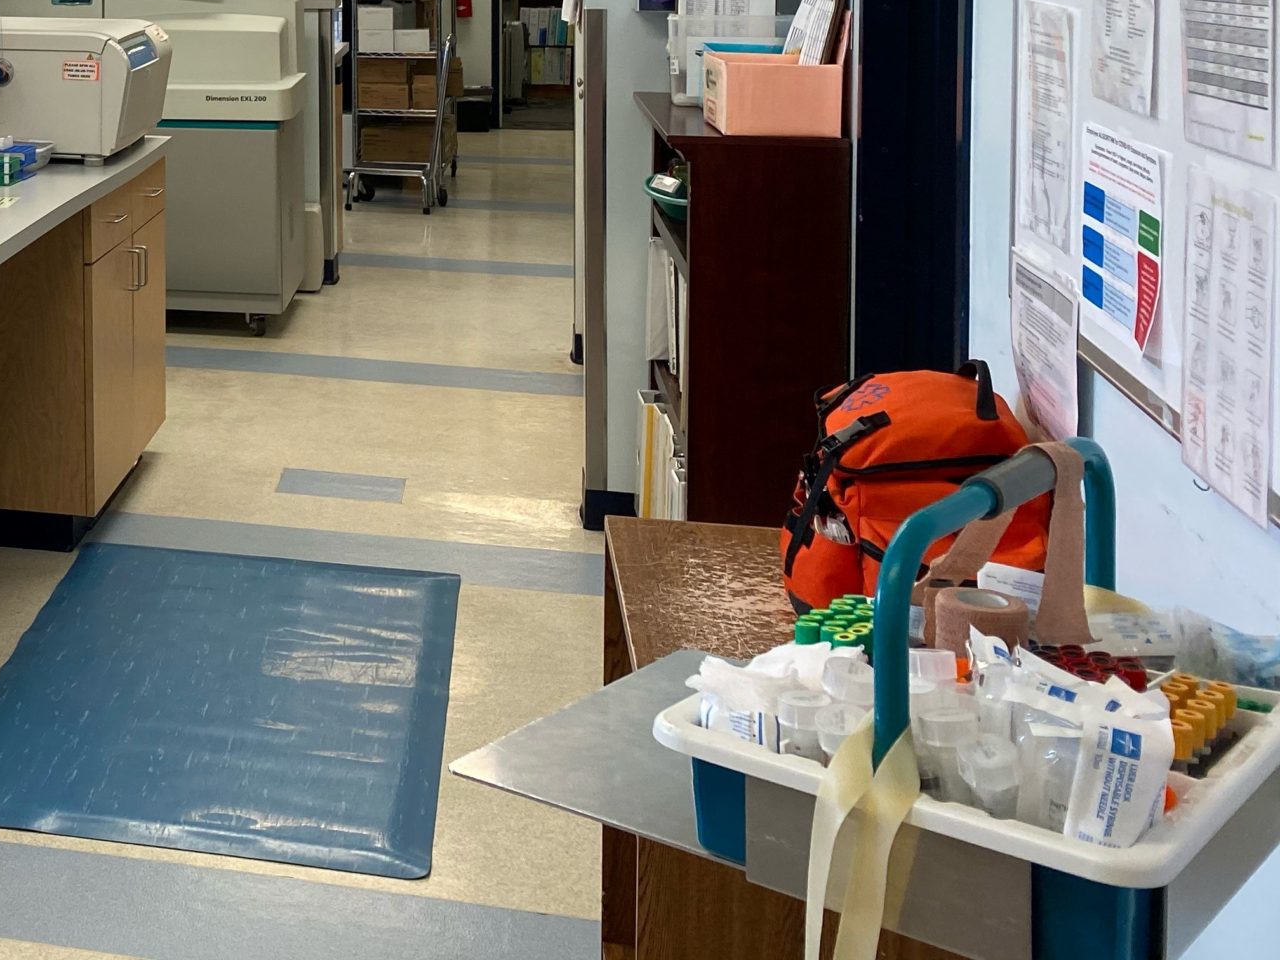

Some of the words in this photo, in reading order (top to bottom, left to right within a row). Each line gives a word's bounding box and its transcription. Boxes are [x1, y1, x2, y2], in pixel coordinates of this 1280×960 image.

[1104, 757, 1116, 792] WITHOUT
[1111, 760, 1128, 807] DISPOSABLE
[1127, 763, 1138, 783] LUER
[1096, 791, 1110, 821] NEEDLE
[1123, 783, 1134, 802] LOCK
[1103, 807, 1119, 838] SYRINGE
